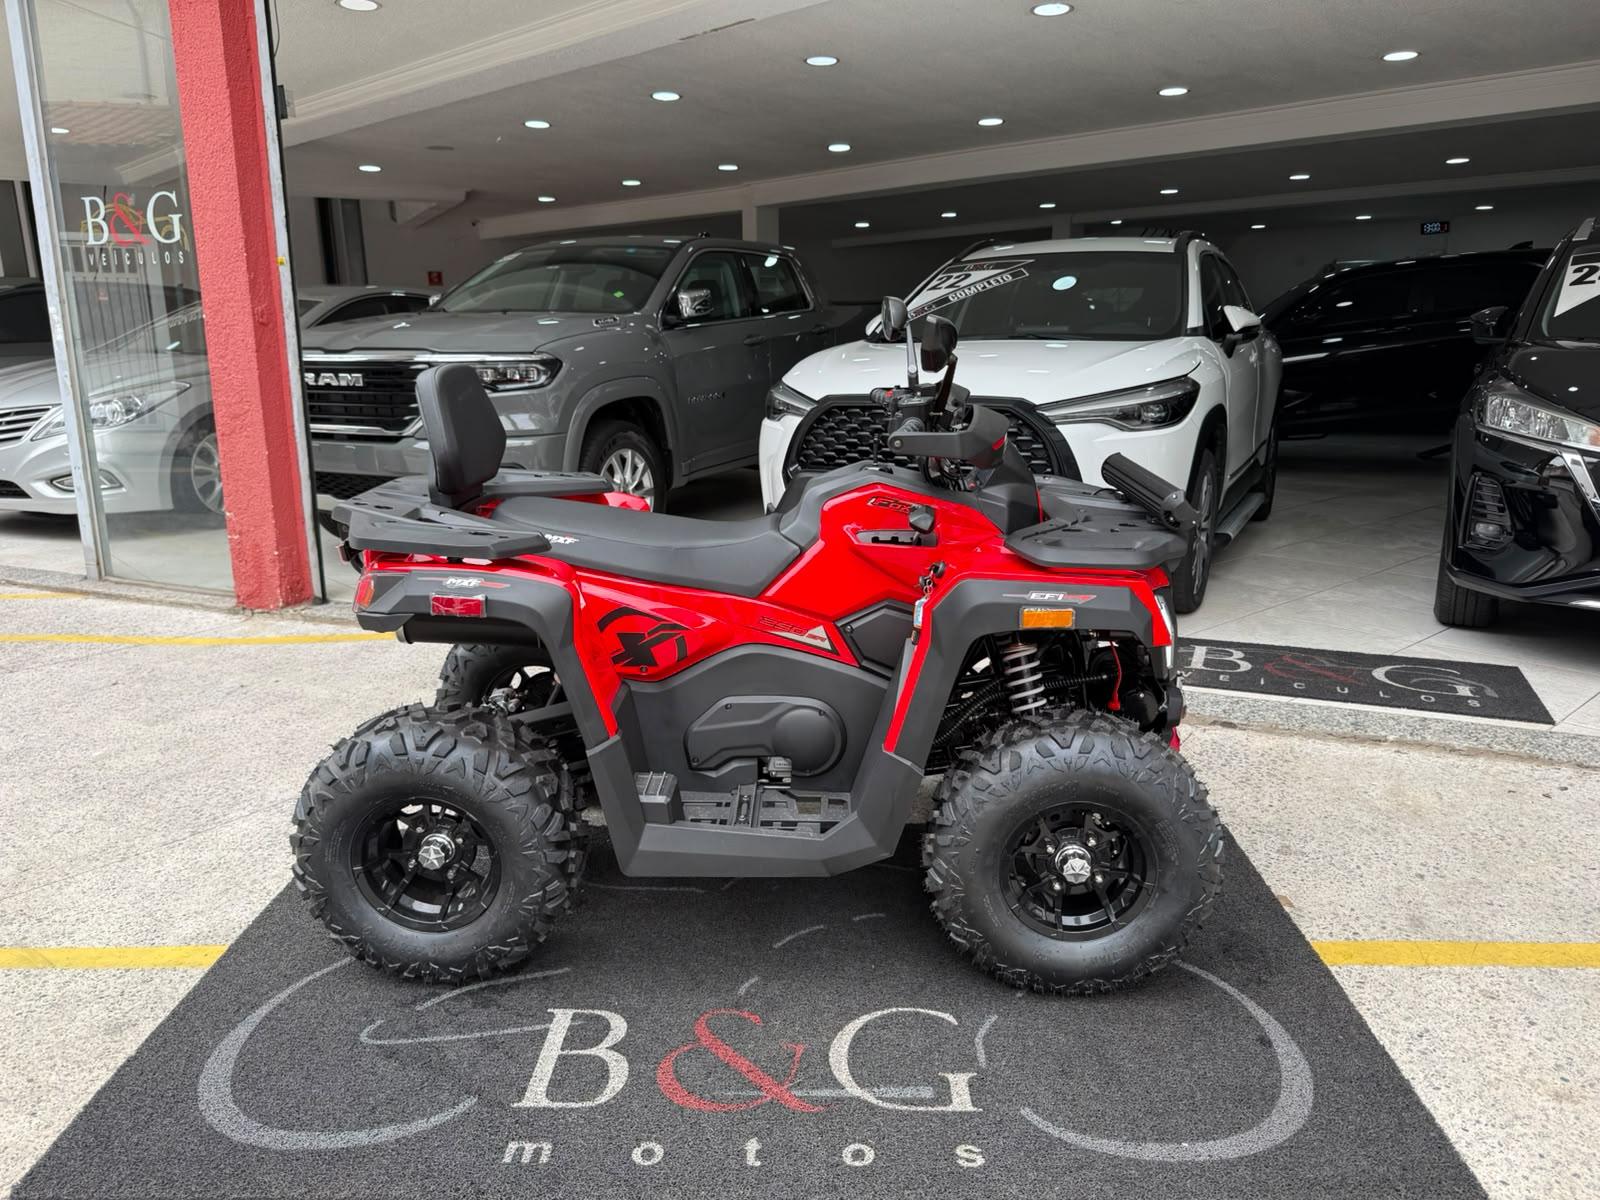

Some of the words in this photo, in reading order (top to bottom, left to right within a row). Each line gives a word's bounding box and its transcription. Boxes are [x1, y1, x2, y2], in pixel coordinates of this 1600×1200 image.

[80, 190, 183, 247] B&G
[88, 251, 184, 266] VEICULOS
[926, 272, 973, 292] 22
[1569, 264, 1600, 286] 2
[948, 273, 1013, 302] COMPLETO
[304, 372, 363, 387] RAM
[1029, 592, 1065, 601] EFI
[512, 1007, 984, 1113] B&G
[502, 1137, 986, 1167] motos
